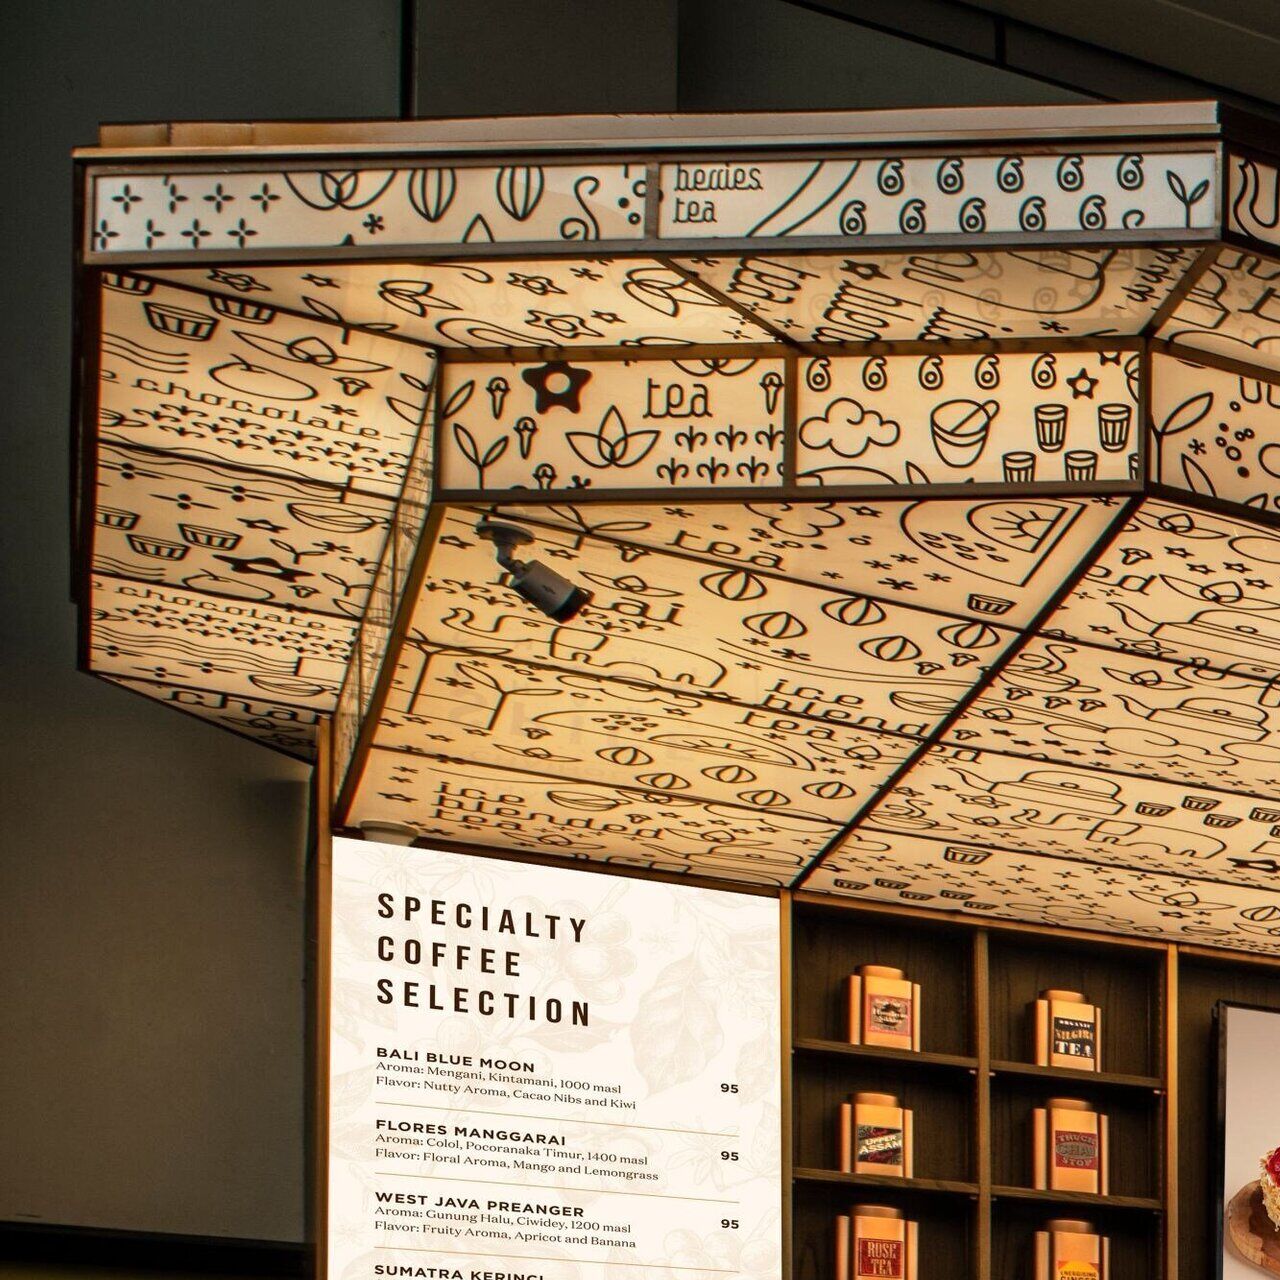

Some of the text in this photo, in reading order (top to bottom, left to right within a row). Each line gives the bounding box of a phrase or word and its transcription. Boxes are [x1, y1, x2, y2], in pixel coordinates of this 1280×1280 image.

[672, 196, 718, 224] tea
[643, 377, 713, 419] tea
[378, 893, 587, 944] SPECIALTY
[378, 935, 521, 978] COFFEE
[377, 978, 589, 1028] SELECTION
[377, 1047, 535, 1074] BALI BLUE MOON
[376, 1062, 622, 1094] Aroma: Mengani, Kintamani, 1000 masl
[720, 1083, 740, 1094] 95
[376, 1076, 636, 1110] Flavor: Nutty Aroma, Cacao Nibs and Kiwi
[376, 1119, 566, 1147] FLORES MANGGARAI
[864, 1134, 898, 1146] UPPER
[375, 1134, 648, 1166] Aroma: Colol, Pocoranaka Timur, 1400 masl
[721, 1151, 740, 1162] 95
[376, 1148, 659, 1181] Flavor: Floral Aroma, Mango and Lemongrass
[375, 1192, 585, 1218] WEST JAVA PREANGER
[375, 1206, 631, 1234] Aroma: Gunung Halu, Ciwidey, 1200 masl
[721, 1219, 740, 1230] 95
[375, 1221, 636, 1249] Flavor: Fruity Aroma, Apricot and Banana
[867, 1241, 897, 1259] ROSE
[374, 1265, 464, 1280] SUMATRA
[871, 1258, 893, 1276] TEA
